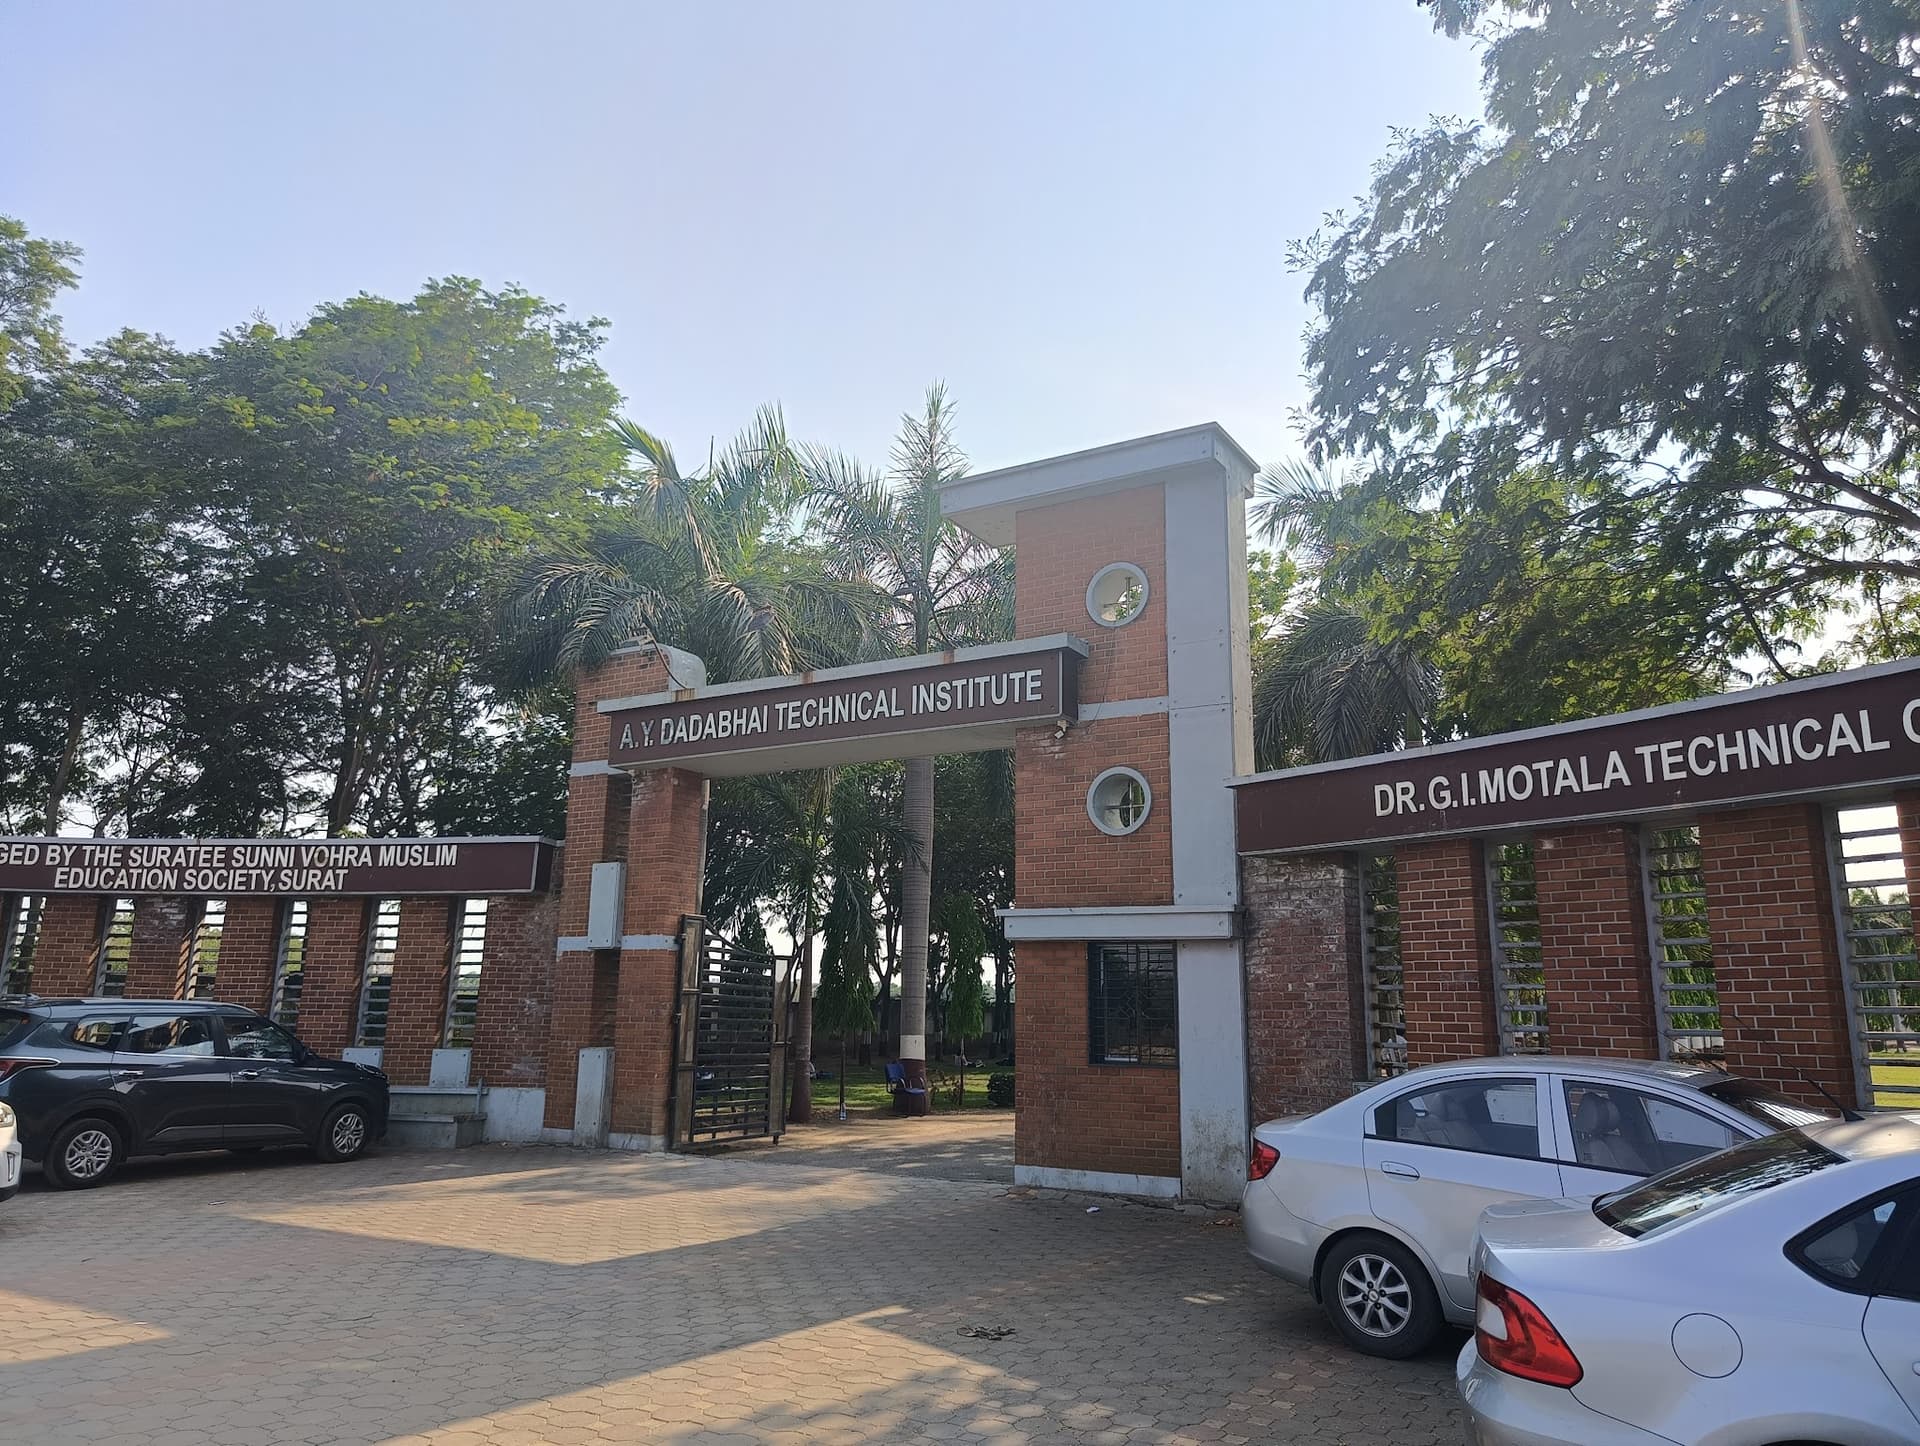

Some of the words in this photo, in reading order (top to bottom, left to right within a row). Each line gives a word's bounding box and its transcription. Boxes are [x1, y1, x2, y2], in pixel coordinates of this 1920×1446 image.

[660, 704, 769, 745] DADABHAI
[775, 686, 905, 732] TECHNICAL
[911, 668, 1044, 714] INSTITUTE
[1635, 709, 1891, 783] TECHNICAL
[45, 844, 77, 867] BY
[82, 845, 123, 867] THE
[128, 845, 227, 868] SURATEE
[231, 846, 296, 868] SUNNI
[301, 845, 373, 868] VOHRA
[378, 844, 458, 867] MUSLIM
[54, 867, 178, 890] EDUCATION
